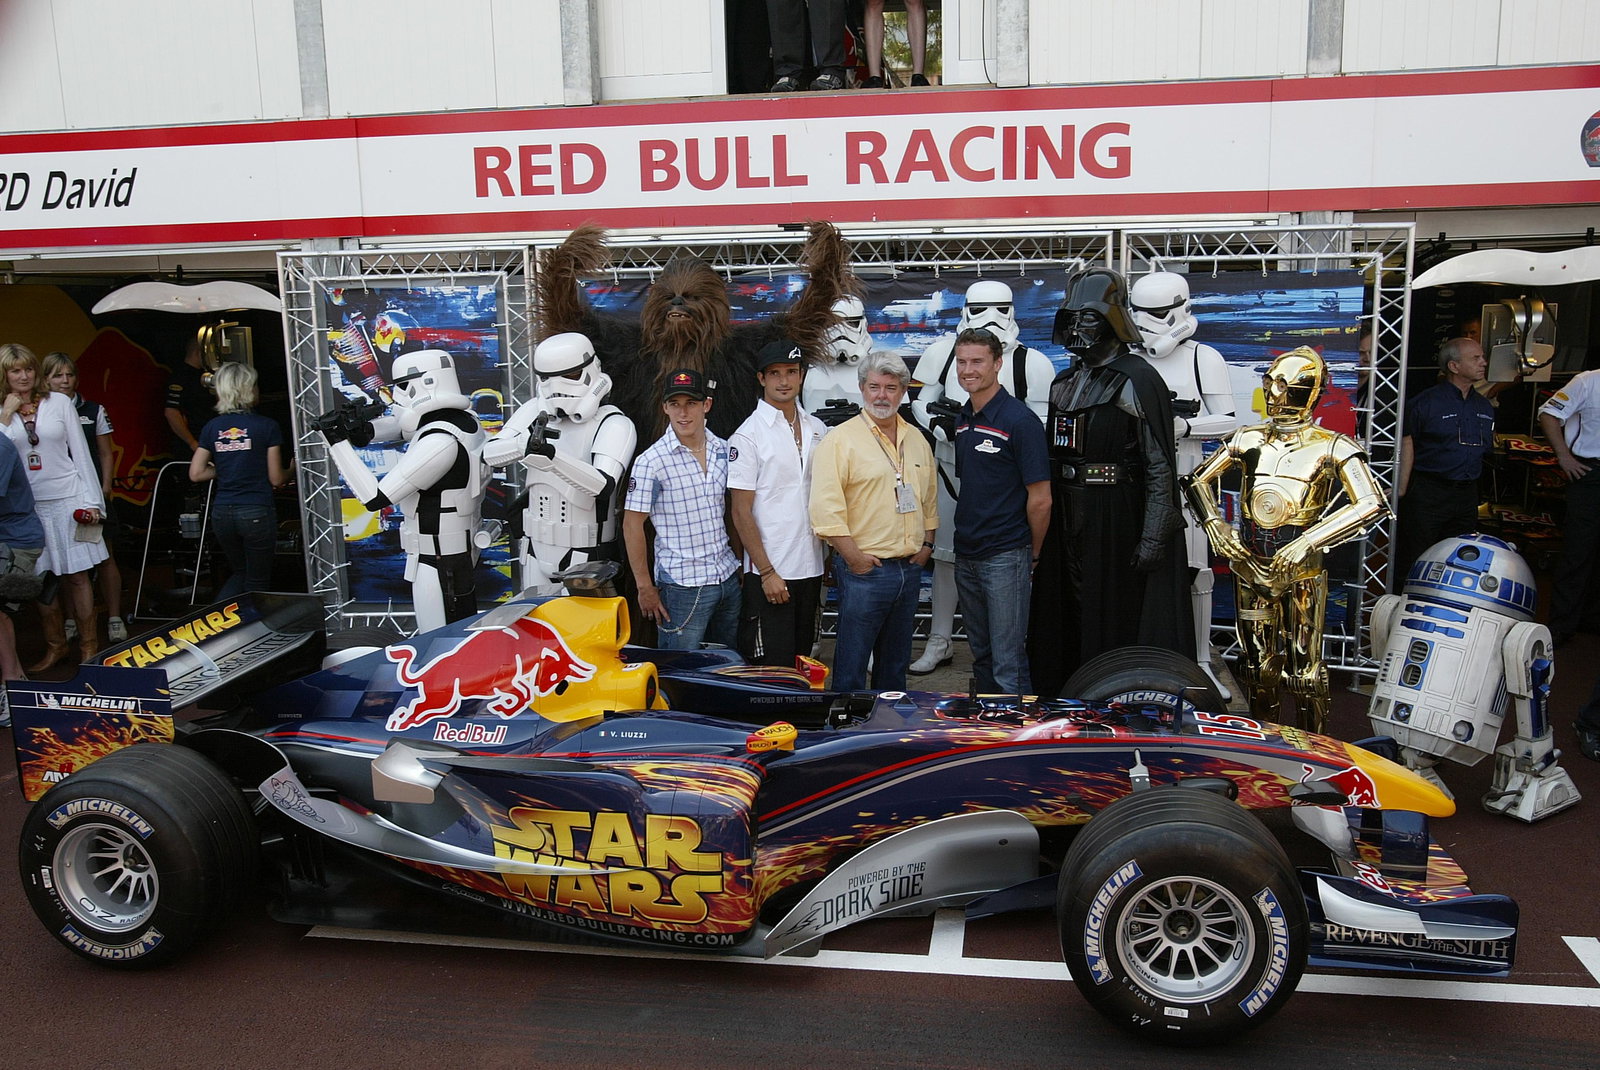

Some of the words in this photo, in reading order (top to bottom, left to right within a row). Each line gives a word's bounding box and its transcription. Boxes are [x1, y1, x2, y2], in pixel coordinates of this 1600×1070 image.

[473, 143, 607, 198] RED
[639, 134, 808, 192] BULL
[845, 122, 1131, 185] RACING
[41, 167, 138, 210] David
[169, 602, 241, 650] WARS
[61, 696, 136, 710] MICHELIN
[620, 731, 647, 739] LIUZZI
[1193, 711, 1266, 740] 15
[67, 799, 151, 835] MICHELIN
[490, 806, 723, 872] STAR
[493, 841, 724, 924] WARS
[848, 868, 889, 889] POWERED
[892, 865, 904, 880] BY
[907, 862, 926, 873] THE
[500, 898, 735, 945] WWW.REDBULLRACING.COM
[820, 885, 875, 929] DARK
[879, 873, 924, 905] SIDE
[1087, 863, 1136, 957] MICHELIN
[63, 930, 146, 959] MICHELIN
[1324, 924, 1431, 949] REVENGE
[1454, 939, 1510, 959] SITH
[1127, 952, 1158, 984] RACING
[1247, 916, 1288, 1014] MICHELIN
